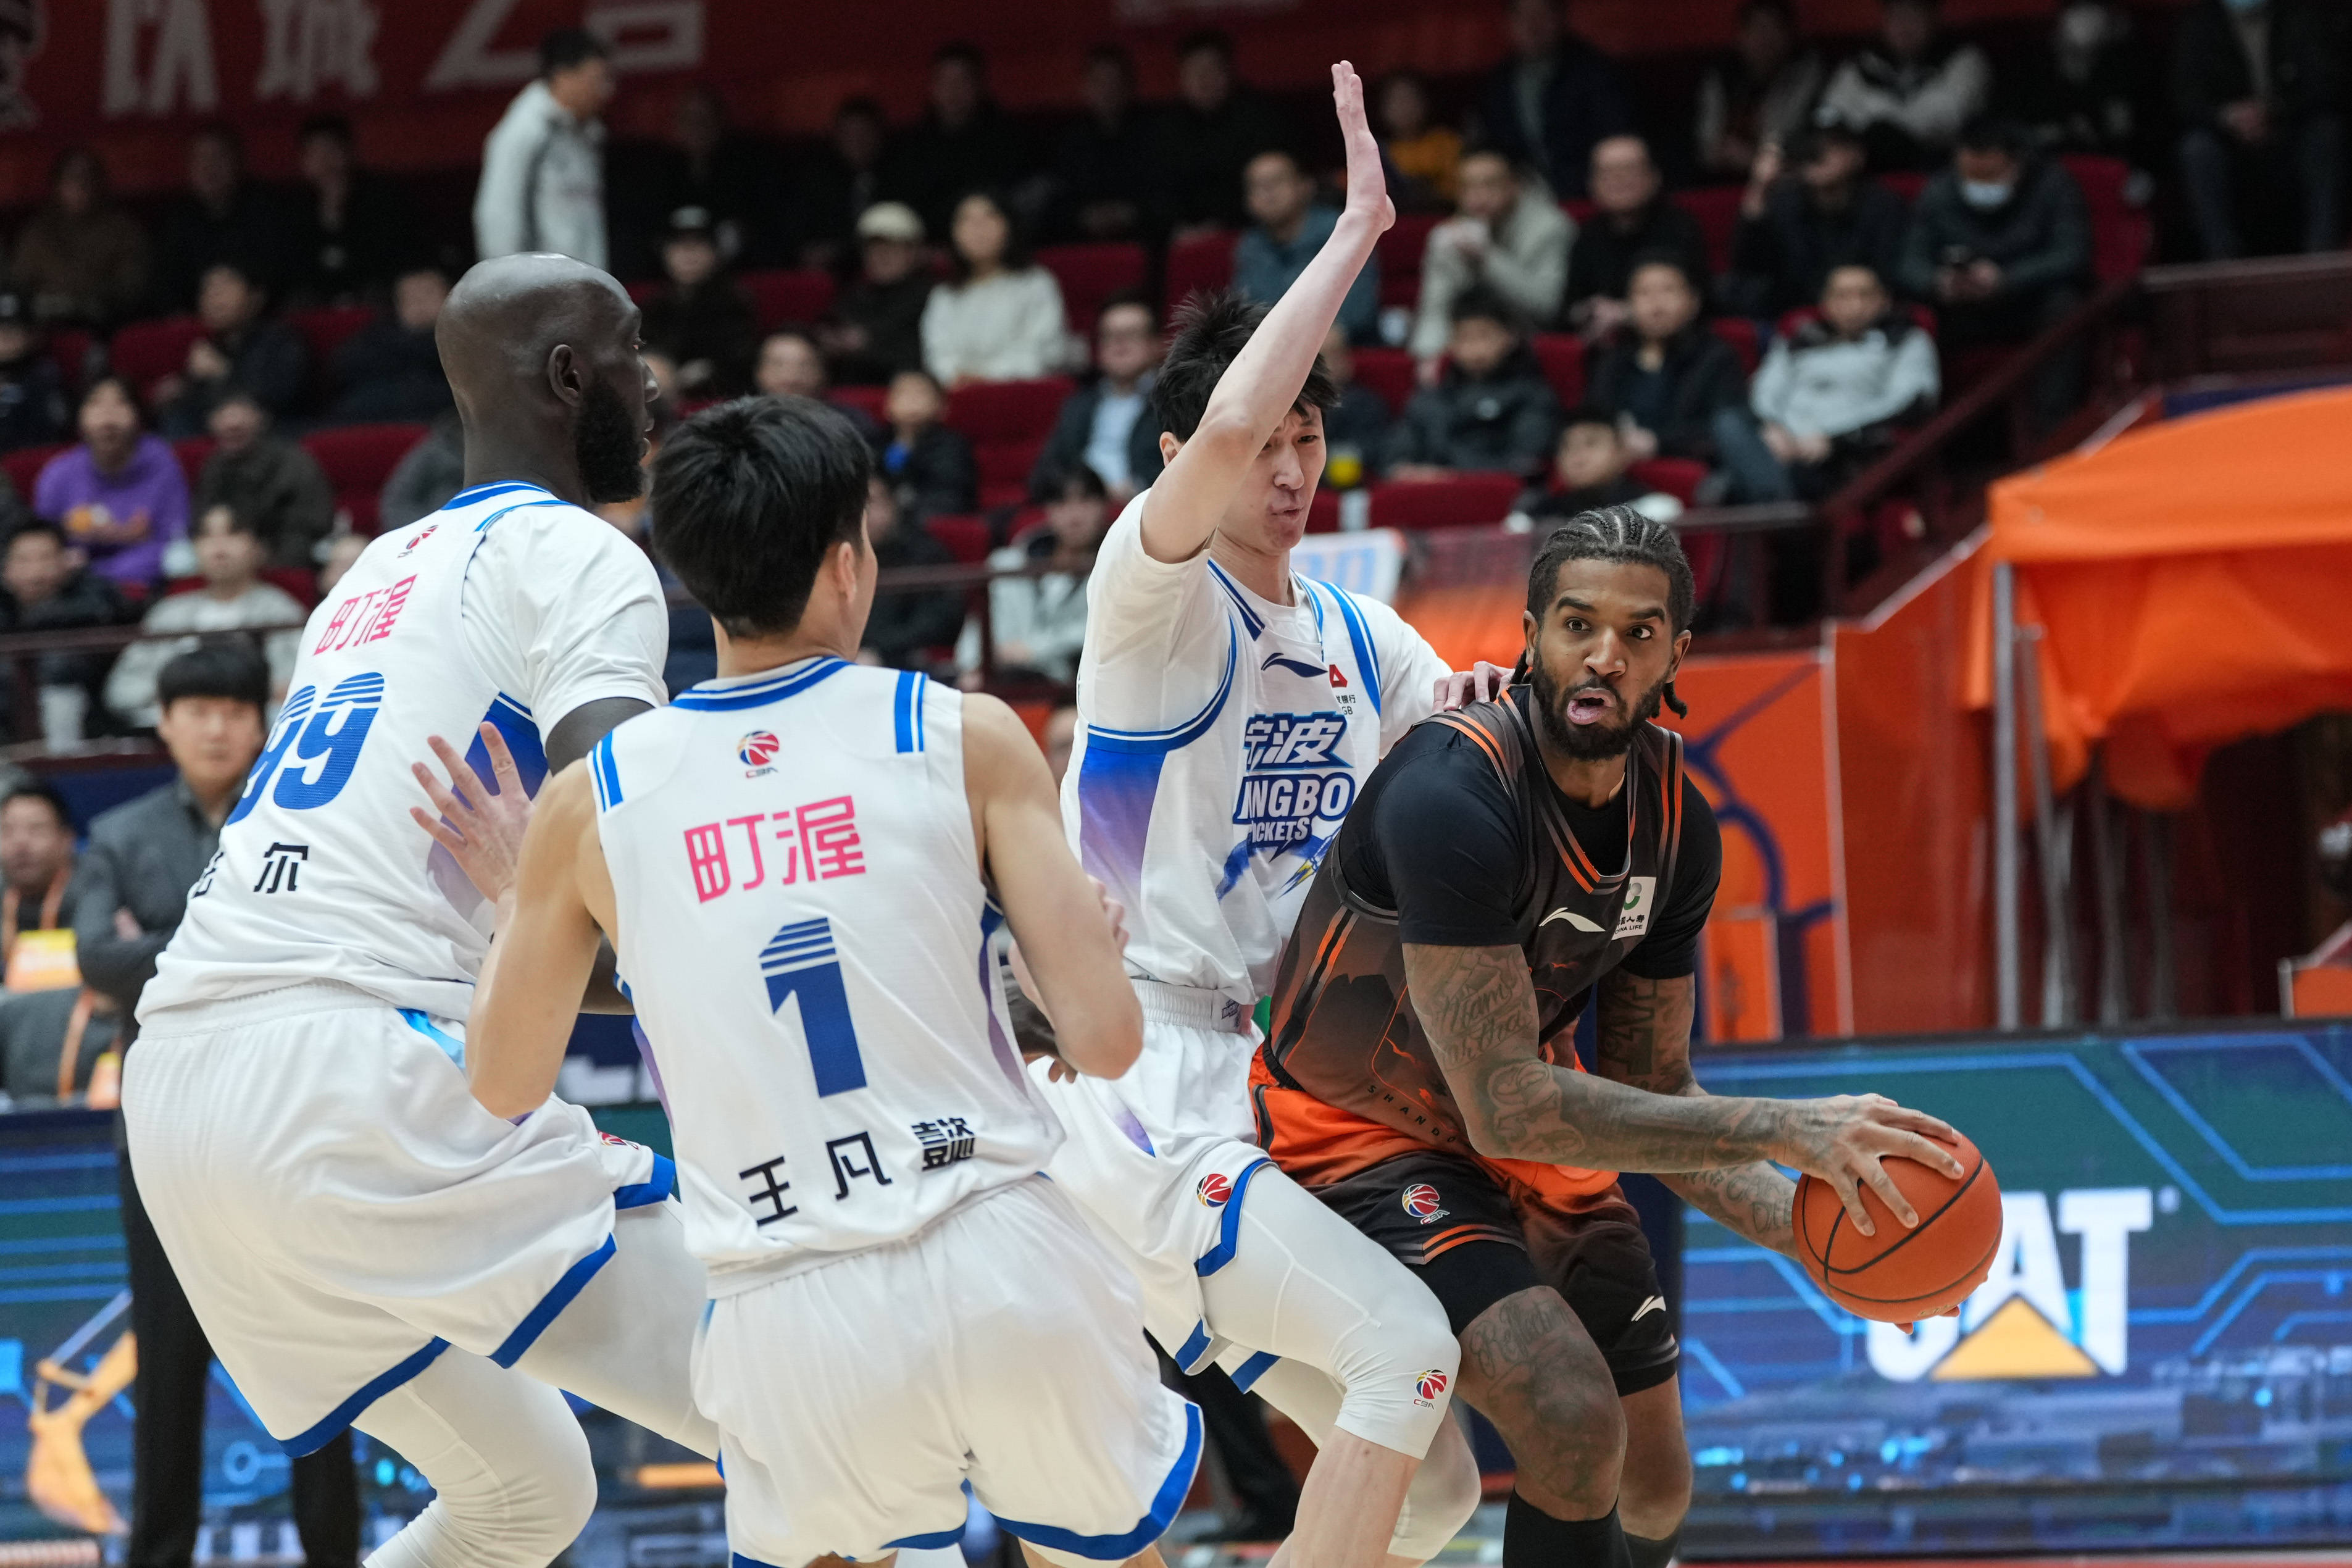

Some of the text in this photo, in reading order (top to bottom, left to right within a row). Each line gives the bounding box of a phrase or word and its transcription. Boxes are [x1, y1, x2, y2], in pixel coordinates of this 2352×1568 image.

[313, 574, 418, 656] 町渥
[226, 671, 385, 826] 99
[683, 796, 866, 903] 町渥
[758, 917, 867, 1098] 1
[1420, 1209, 1450, 1225] CBA
[1413, 1398, 1435, 1410] CBA
